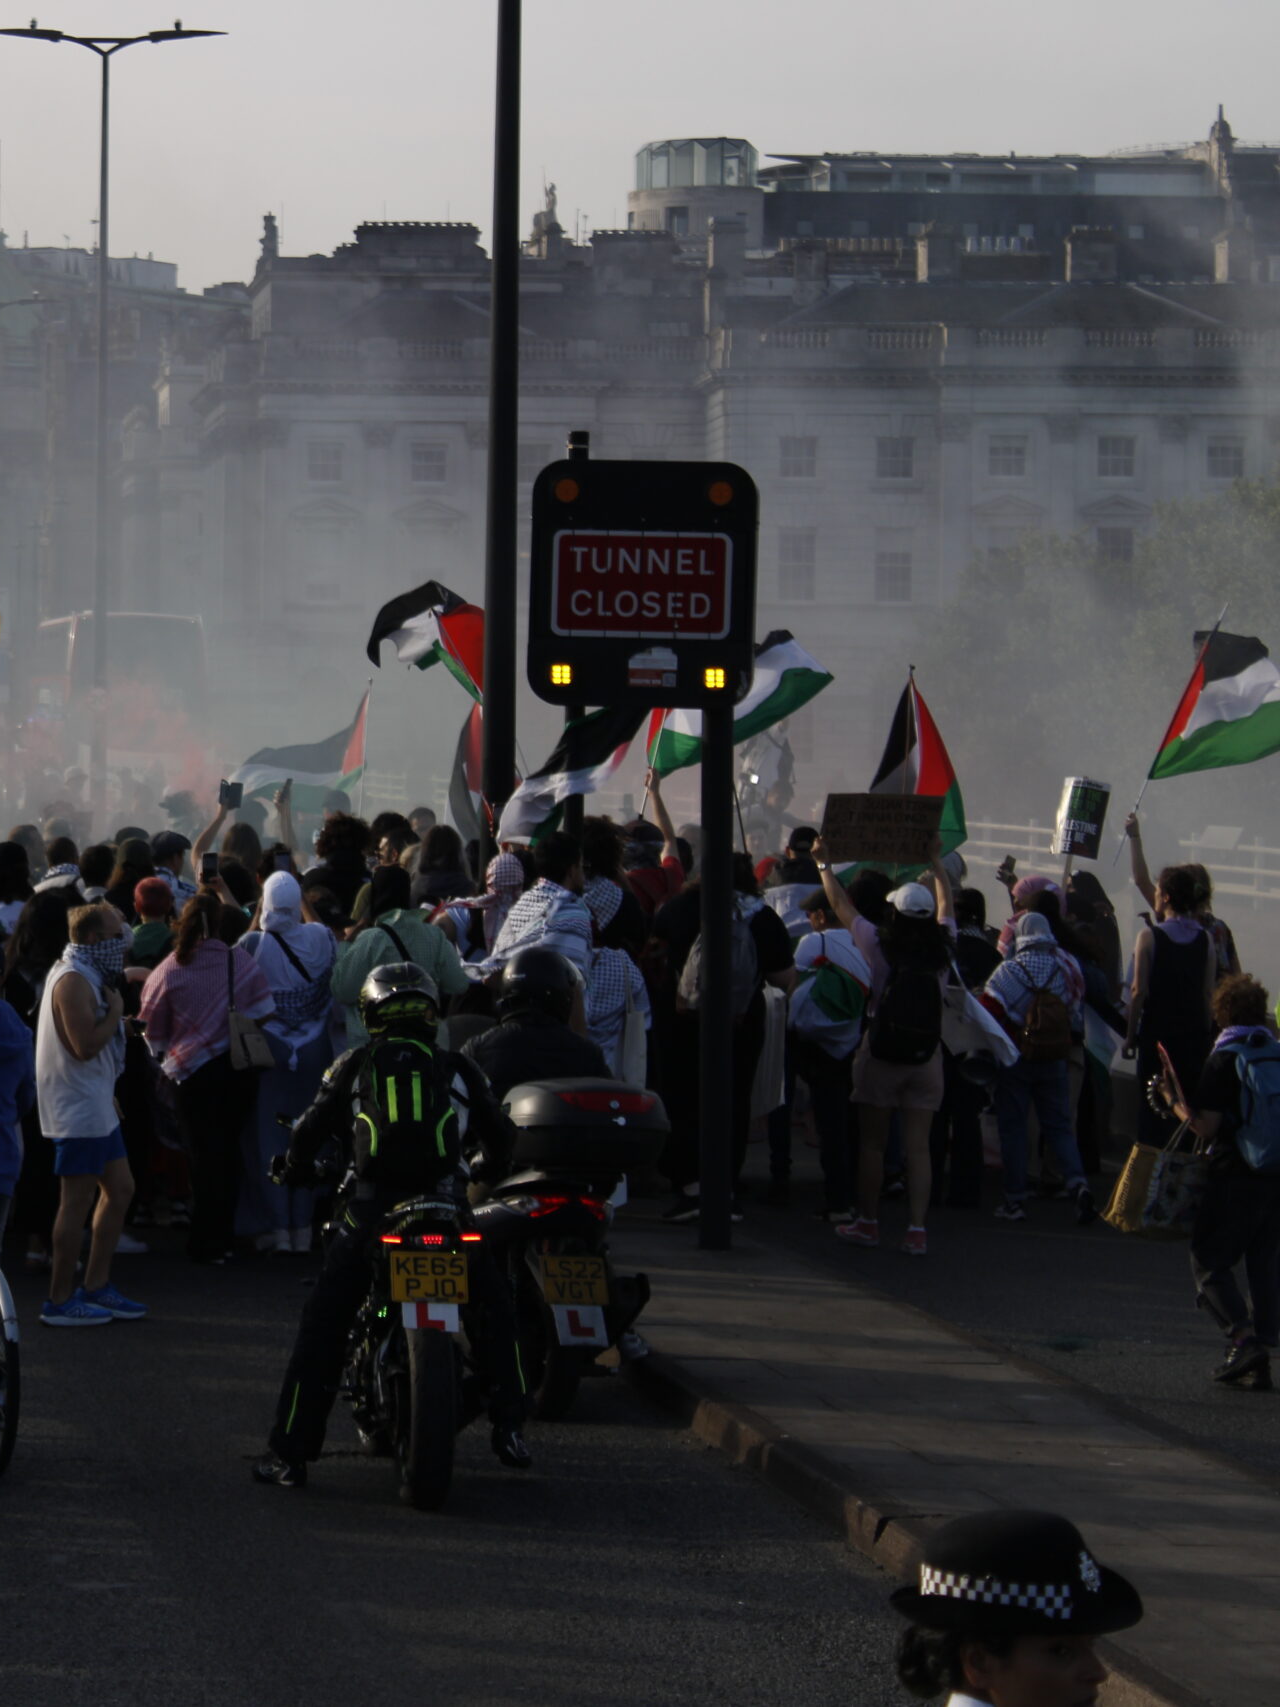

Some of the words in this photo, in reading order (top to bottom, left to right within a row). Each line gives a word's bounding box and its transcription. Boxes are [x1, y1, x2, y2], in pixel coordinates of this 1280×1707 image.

[571, 546, 715, 576] TUNNEL
[570, 589, 712, 619] CLOSED
[1061, 819, 1098, 836] LESTINE
[396, 1257, 464, 1276] KE65
[544, 1259, 602, 1279] LS22
[406, 1278, 457, 1297] PJO
[416, 1302, 445, 1331] L
[566, 1310, 596, 1337] L
